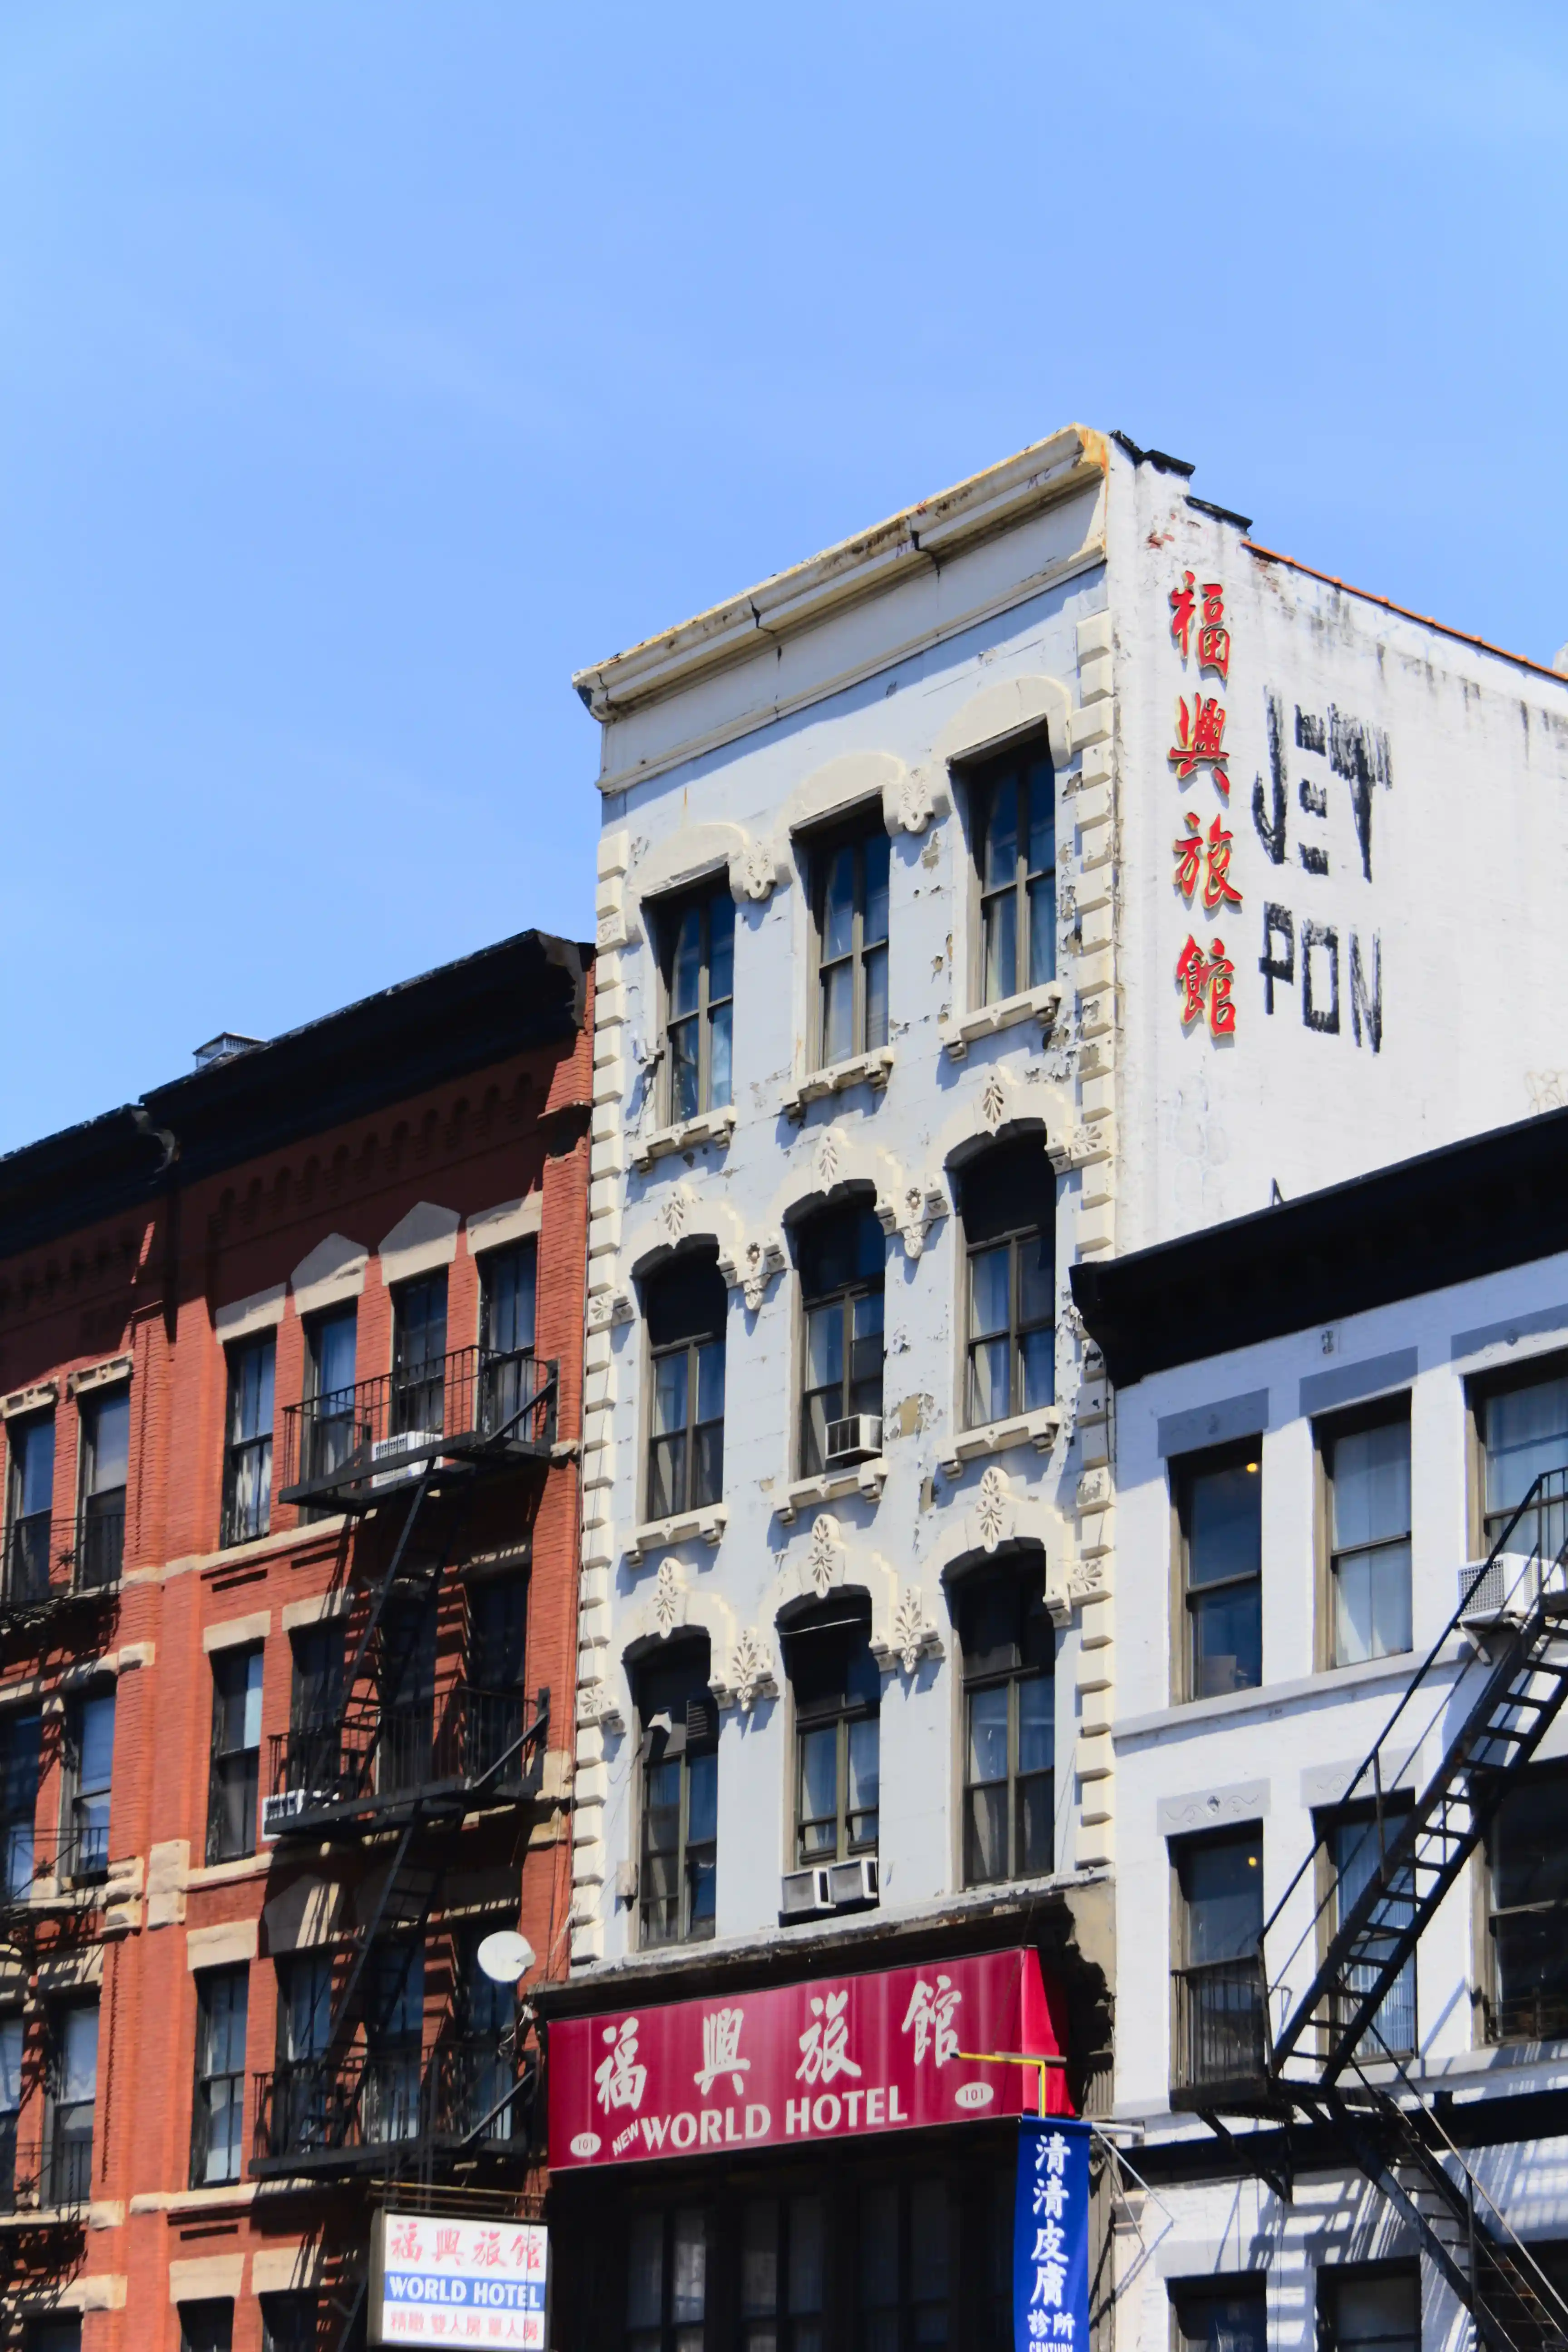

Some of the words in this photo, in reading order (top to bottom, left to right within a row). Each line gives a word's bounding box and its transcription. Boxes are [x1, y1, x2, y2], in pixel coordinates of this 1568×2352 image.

[1168, 571, 1243, 1038] 福興旅館
[1259, 901, 1382, 1055] PON
[595, 1975, 961, 2114] 福興旅館
[612, 2119, 638, 2156] NEW
[641, 2104, 771, 2151] WORLD
[785, 2086, 907, 2134] HOTEL
[964, 2088, 984, 2102] 101
[578, 2137, 593, 2151] 101
[391, 2223, 542, 2269] 福興旅館
[1030, 2132, 1071, 2308] 清清皮膚
[389, 2276, 466, 2302] WORLD
[473, 2282, 540, 2308] HOTEL
[1027, 2308, 1075, 2340] 診所
